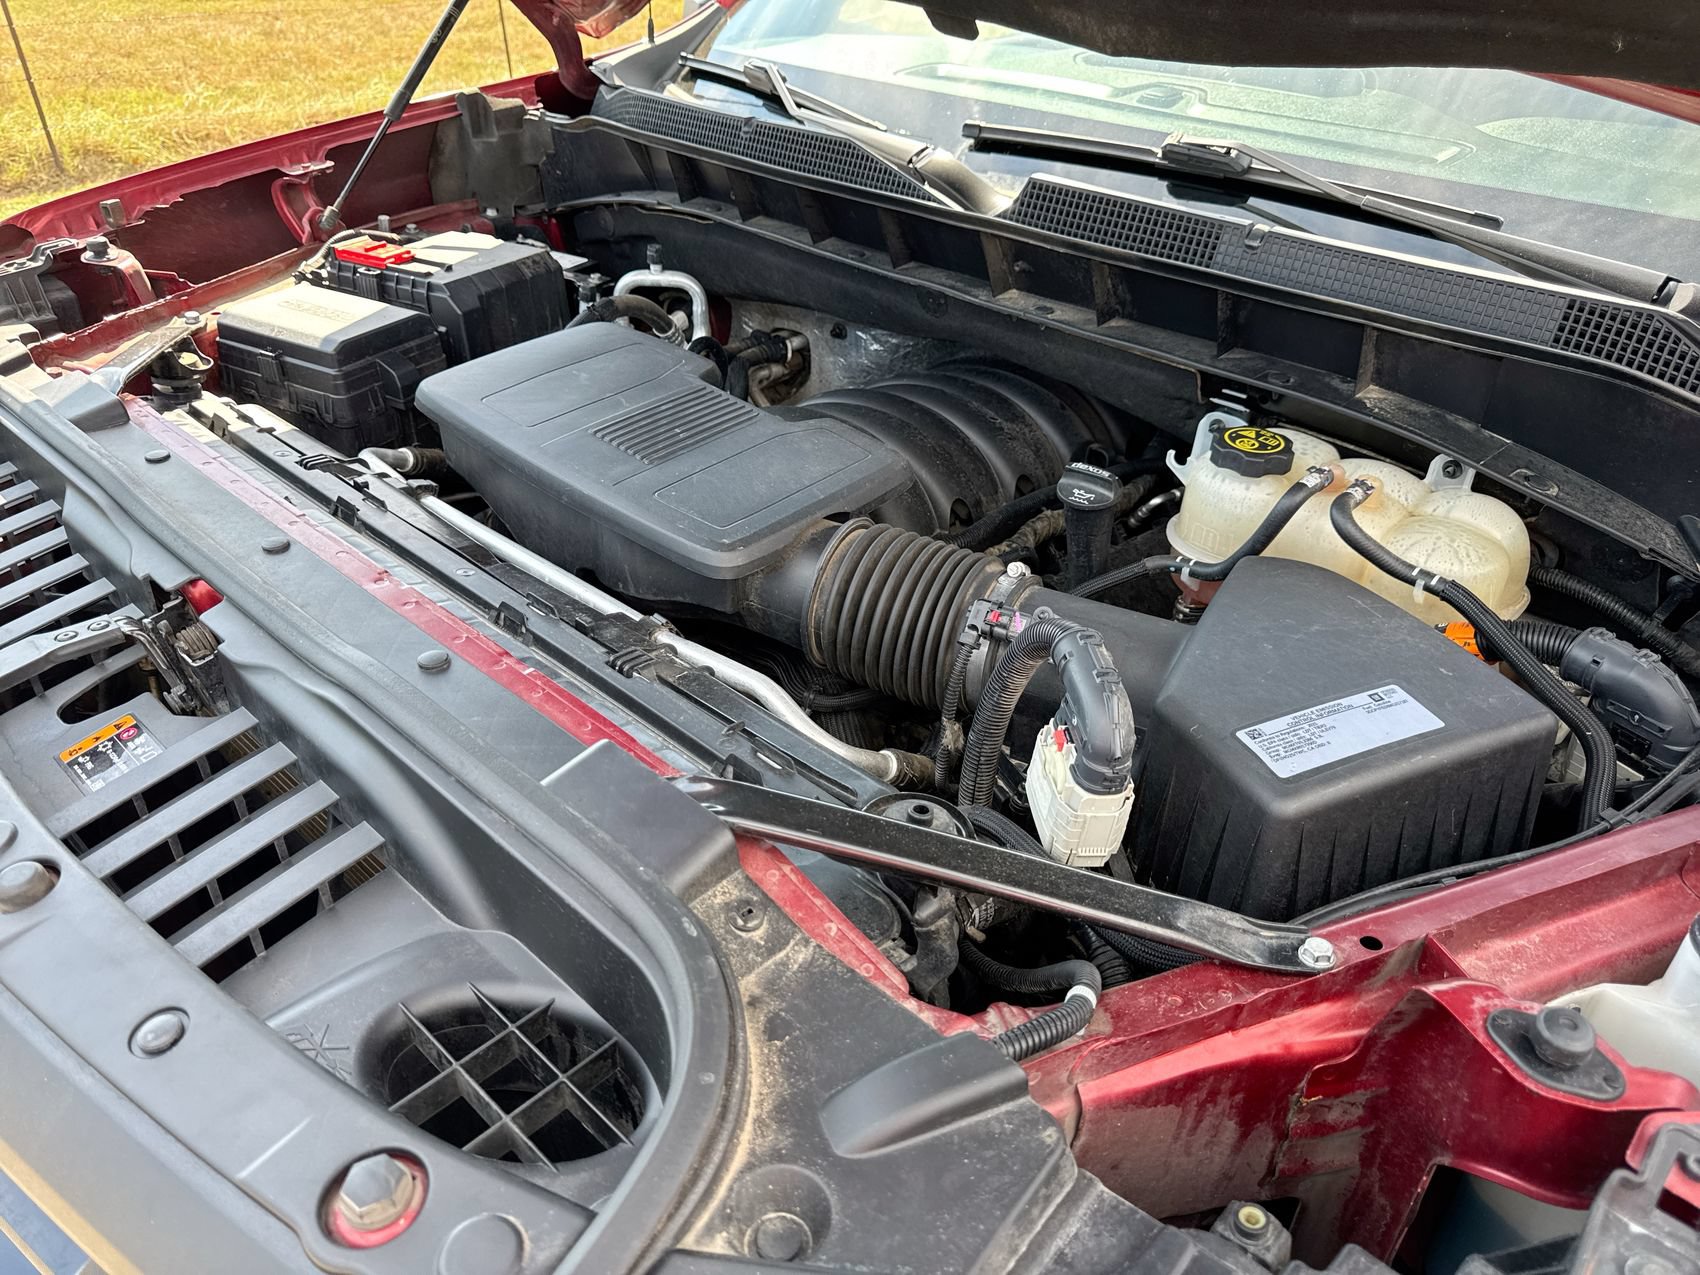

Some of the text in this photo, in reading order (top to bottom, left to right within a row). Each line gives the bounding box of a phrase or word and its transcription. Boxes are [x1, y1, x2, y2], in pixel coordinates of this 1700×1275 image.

[1071, 462, 1111, 477] dexos
[1287, 717, 1314, 727] CONTROL
[1315, 703, 1354, 717] INFORMATION
[1290, 702, 1343, 720] VEHICLE EMISSION
